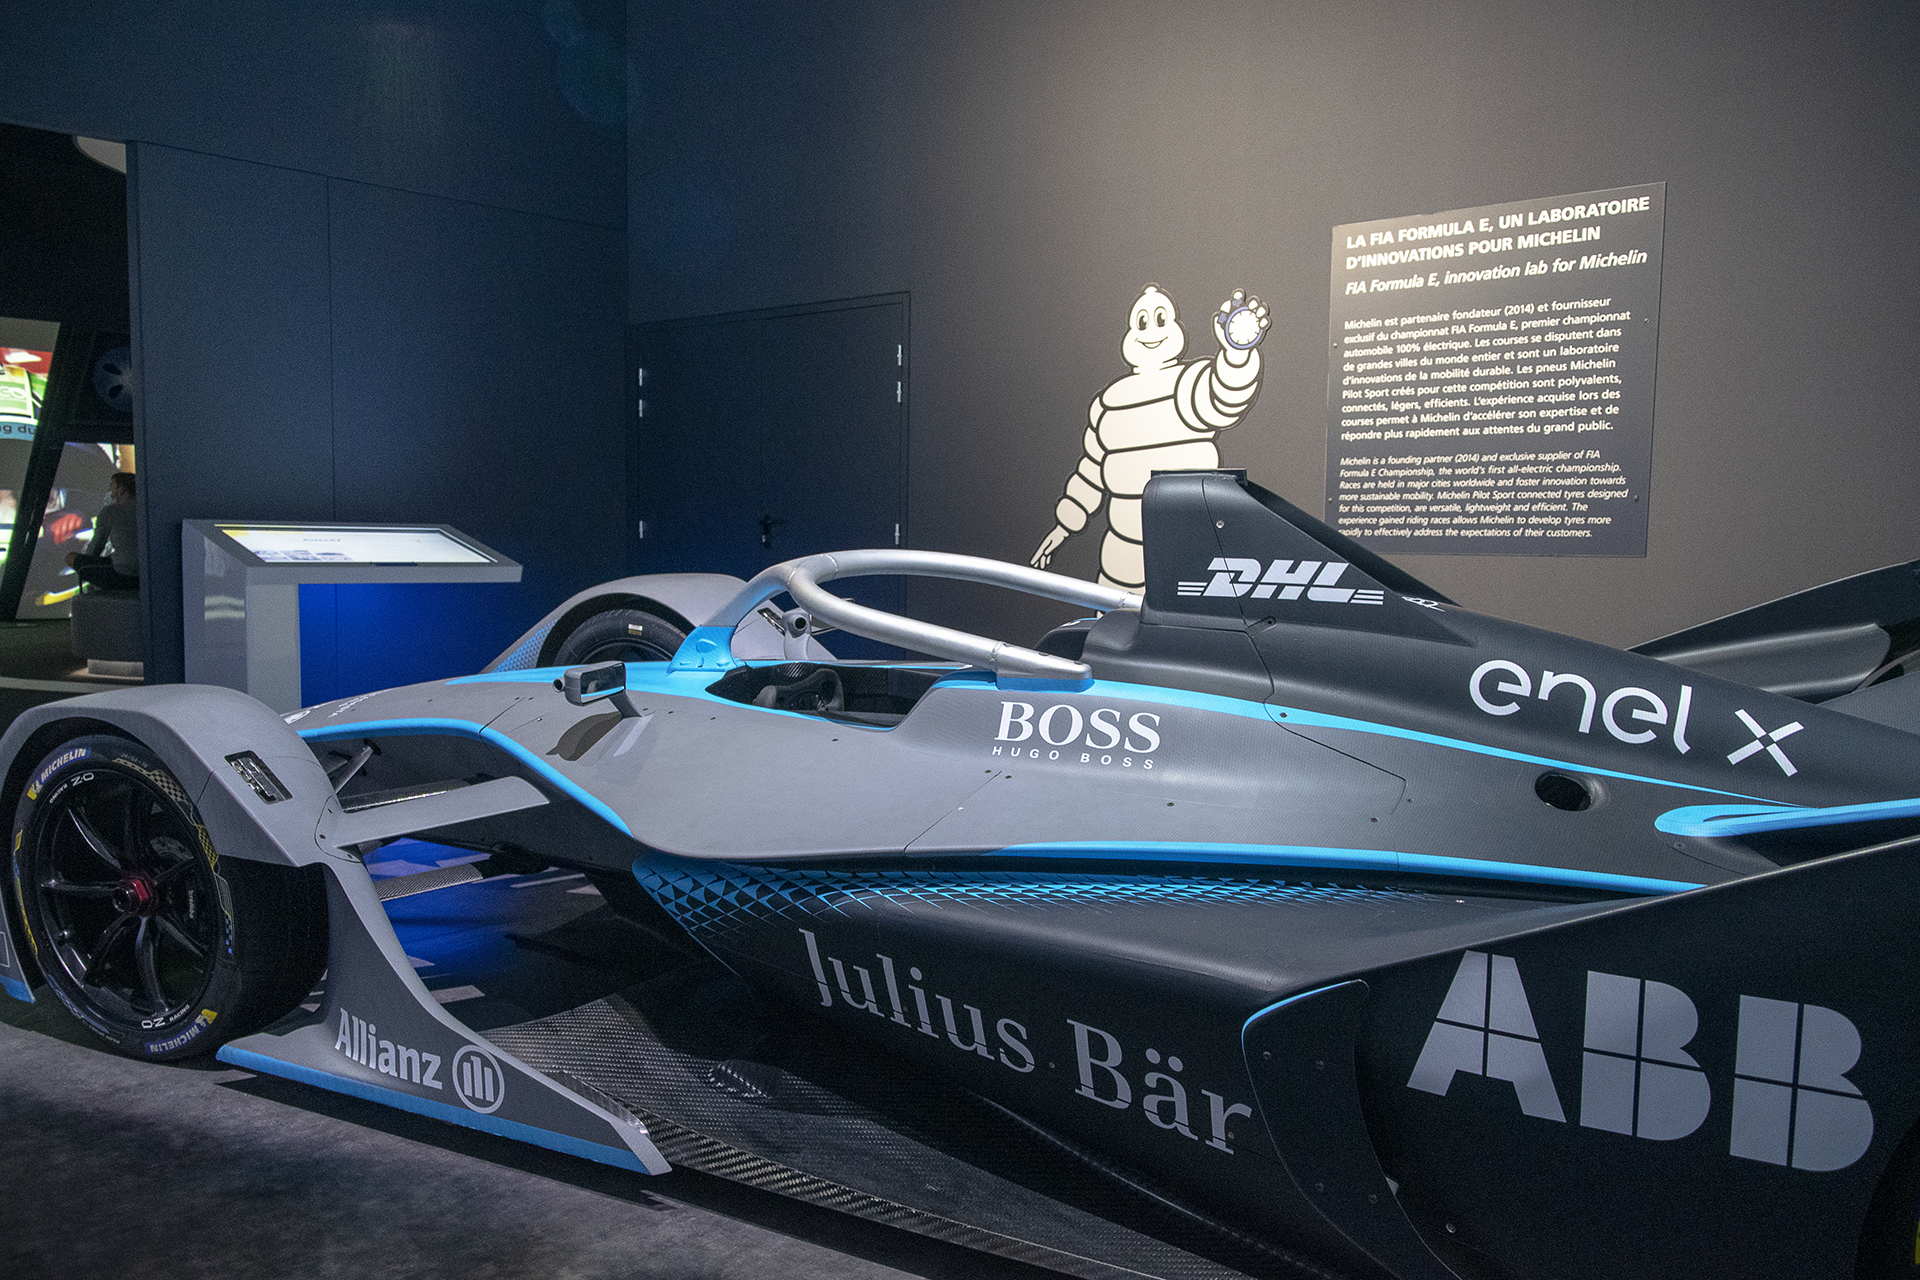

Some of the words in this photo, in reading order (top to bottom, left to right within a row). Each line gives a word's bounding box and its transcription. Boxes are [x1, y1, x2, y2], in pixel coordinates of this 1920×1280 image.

[1346, 235, 1366, 248] LA
[1370, 231, 1394, 245] FIA
[1398, 220, 1475, 242] FORMULA
[1478, 218, 1493, 232] E,
[1498, 213, 1523, 229] UN
[1527, 196, 1650, 225] LABORATOIRE
[1468, 237, 1513, 255] POUR
[1517, 225, 1600, 249] MICHELIN
[1345, 280, 1366, 295] FIA
[1369, 274, 1424, 292] Formula
[1426, 272, 1440, 287] E,
[1443, 264, 1521, 284] innovation
[1523, 259, 1548, 276] lab
[1551, 257, 1577, 273] for
[1578, 249, 1648, 270] Michelin
[1343, 331, 1374, 344] exclusif
[1376, 331, 1388, 341] du
[1390, 326, 1449, 339] championnat
[1451, 324, 1466, 334] FIA
[1468, 320, 1507, 333] Formula
[1509, 320, 1519, 330] E,
[1520, 316, 1560, 331] premier
[1562, 310, 1630, 325] championnat
[1344, 318, 1382, 329] Michelin
[1383, 317, 1398, 326] est
[1400, 312, 1450, 326] partenaire
[1451, 308, 1502, 320] fondateur
[1503, 303, 1535, 316] (2014)
[1536, 302, 1549, 312] et
[1550, 298, 1611, 311] fournisseur
[1343, 345, 1393, 357] automobile
[1395, 342, 1420, 353] 100%
[1422, 339, 1472, 351] électrique.
[1474, 338, 1490, 347] Les
[1491, 335, 1529, 346] courses
[1530, 334, 1542, 343] se
[1543, 329, 1594, 343] disputent
[1595, 327, 1622, 338] dans
[1342, 361, 1355, 371] de
[1356, 359, 1392, 373] grandes
[1394, 357, 1418, 367] villes
[1419, 356, 1432, 366] du
[1434, 353, 1469, 364] monde
[1471, 351, 1501, 362] entier
[1503, 350, 1515, 360] et
[1517, 348, 1540, 359] sont
[1542, 348, 1556, 357] un
[1559, 342, 1619, 356] laboratoire
[1404, 371, 1417, 381] de
[1419, 370, 1428, 380] la
[1430, 367, 1470, 379] mobilité
[1472, 365, 1514, 377] durable.
[1516, 364, 1533, 374] Les
[1535, 363, 1567, 375] pneus
[1570, 357, 1616, 370] Michelin
[1341, 401, 1388, 413] connectés,
[1390, 400, 1421, 412] légers,
[1423, 397, 1471, 408] efficients.
[1536, 391, 1575, 404] acquise
[1578, 390, 1599, 400] lors
[1600, 388, 1620, 399] des
[1342, 389, 1362, 399] Pilot
[1364, 388, 1389, 399] Sport
[1391, 386, 1415, 396] créés
[1416, 386, 1440, 396] pour
[1442, 383, 1467, 393] cette
[1469, 379, 1529, 392] compétition
[1531, 378, 1555, 388] sont
[1557, 374, 1622, 388] polyvalents,
[1340, 418, 1374, 427] courses
[1375, 415, 1409, 427] permet
[1411, 414, 1418, 423] à
[1420, 412, 1460, 423] Michelin
[1517, 410, 1536, 418] son
[1538, 406, 1587, 419] expertise
[1589, 405, 1602, 415] et
[1604, 404, 1619, 414] de
[1340, 429, 1382, 442] répondre
[1383, 429, 1403, 440] plus
[1404, 427, 1460, 439] rapidement
[1461, 427, 1480, 435] aux
[1482, 424, 1524, 435] attentes
[1526, 422, 1541, 433] du
[1542, 421, 1575, 435] grand
[1577, 419, 1614, 433] public.
[1339, 456, 1371, 466] Michelin
[1387, 455, 1422, 465] founding
[1422, 455, 1453, 465] partner
[1454, 453, 1480, 463] (2014)
[1480, 452, 1498, 462] and
[1498, 451, 1536, 461] exclusive
[1536, 450, 1572, 462] supplier
[1573, 449, 1585, 459] of
[1585, 449, 1600, 458] FIA
[1339, 468, 1369, 477] Formula
[1370, 468, 1376, 477] E
[1438, 466, 1453, 475] the
[1487, 464, 1505, 474] first
[1506, 464, 1553, 474] all-electric
[1338, 480, 1361, 489] Races
[1377, 480, 1395, 488] held
[1406, 480, 1429, 489] major
[1452, 477, 1495, 487] worldwide
[1496, 477, 1514, 486] and
[1515, 477, 1540, 486] foster
[1541, 476, 1587, 485] innovation
[1589, 475, 1626, 485] towards
[1359, 492, 1401, 500] sustainable
[1436, 491, 1470, 499] Michelin
[1471, 490, 1490, 499] Pilot
[1491, 490, 1515, 500] Sport
[1516, 489, 1562, 499] connected
[1563, 490, 1585, 500] tyres
[1586, 488, 1629, 500] designed
[1464, 502, 1511, 514] lightweight
[1512, 502, 1530, 511] and
[1571, 502, 1588, 511] The
[1202, 557, 1358, 603] DHL
[1469, 659, 1692, 755] enel
[994, 700, 1161, 754] BOSS
[41, 748, 87, 783] MICHELIN
[991, 746, 1060, 760] HUGO
[1080, 751, 1155, 770] BOSS
[169, 1004, 191, 1022] RACING
[150, 1024, 201, 1053] MICHELIN
[335, 1007, 444, 1091] Allianz
[798, 927, 1036, 1074] Julius
[1066, 1018, 1253, 1156] Bär
[1406, 949, 1874, 1173] ABB
